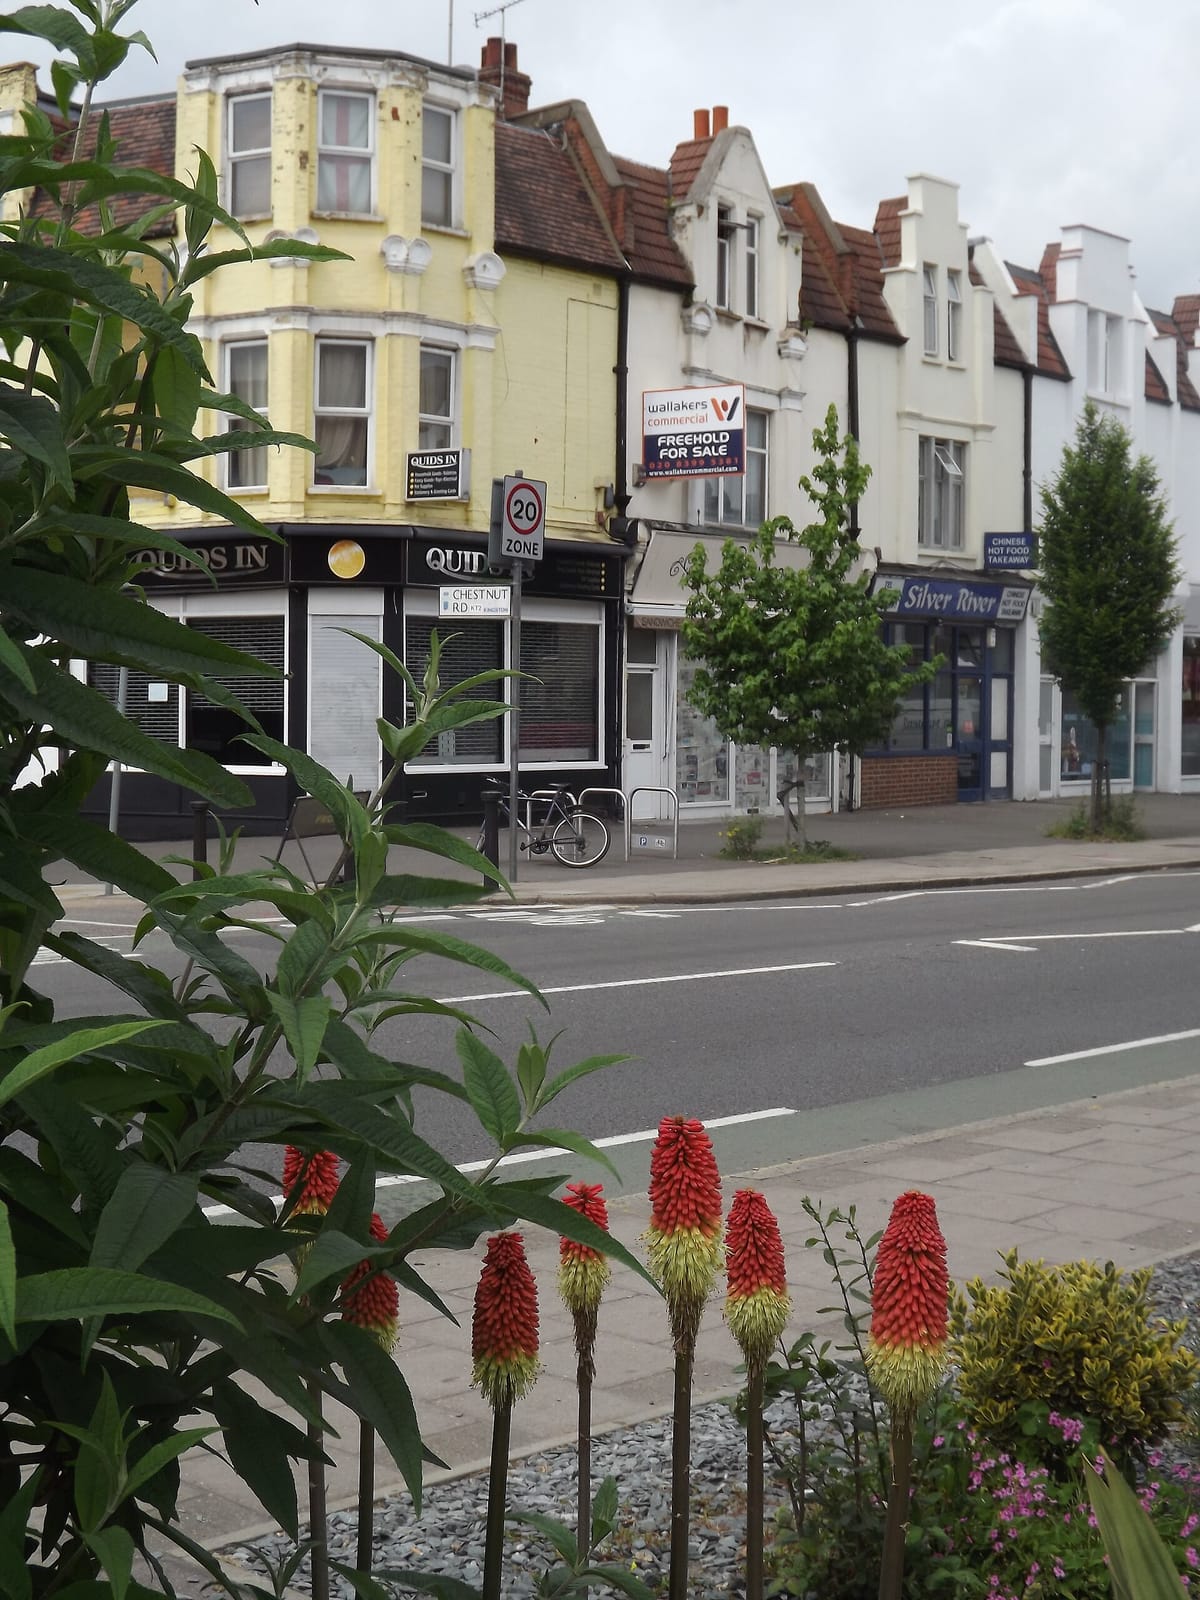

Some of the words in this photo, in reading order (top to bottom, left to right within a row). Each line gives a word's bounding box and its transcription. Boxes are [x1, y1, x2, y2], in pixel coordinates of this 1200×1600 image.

[648, 400, 708, 413] wallakers
[647, 413, 708, 427] commercial
[657, 431, 730, 447] FREEHOLD
[659, 447, 688, 460] FOR
[692, 444, 728, 458] SALE
[410, 455, 444, 468] QUIDS
[445, 454, 458, 465] IN
[513, 498, 537, 522] 20
[506, 538, 540, 556] ZONE
[992, 537, 1027, 546] CHINESE
[235, 544, 269, 568] IN
[988, 546, 1005, 555] HOT
[1006, 546, 1030, 555] FOOD
[426, 547, 500, 575] QUID
[988, 555, 1030, 564] TAKEAWAY
[452, 588, 509, 601] CHESTNUT
[904, 583, 953, 611] Silver
[956, 587, 998, 614] River
[452, 602, 468, 613] RD
